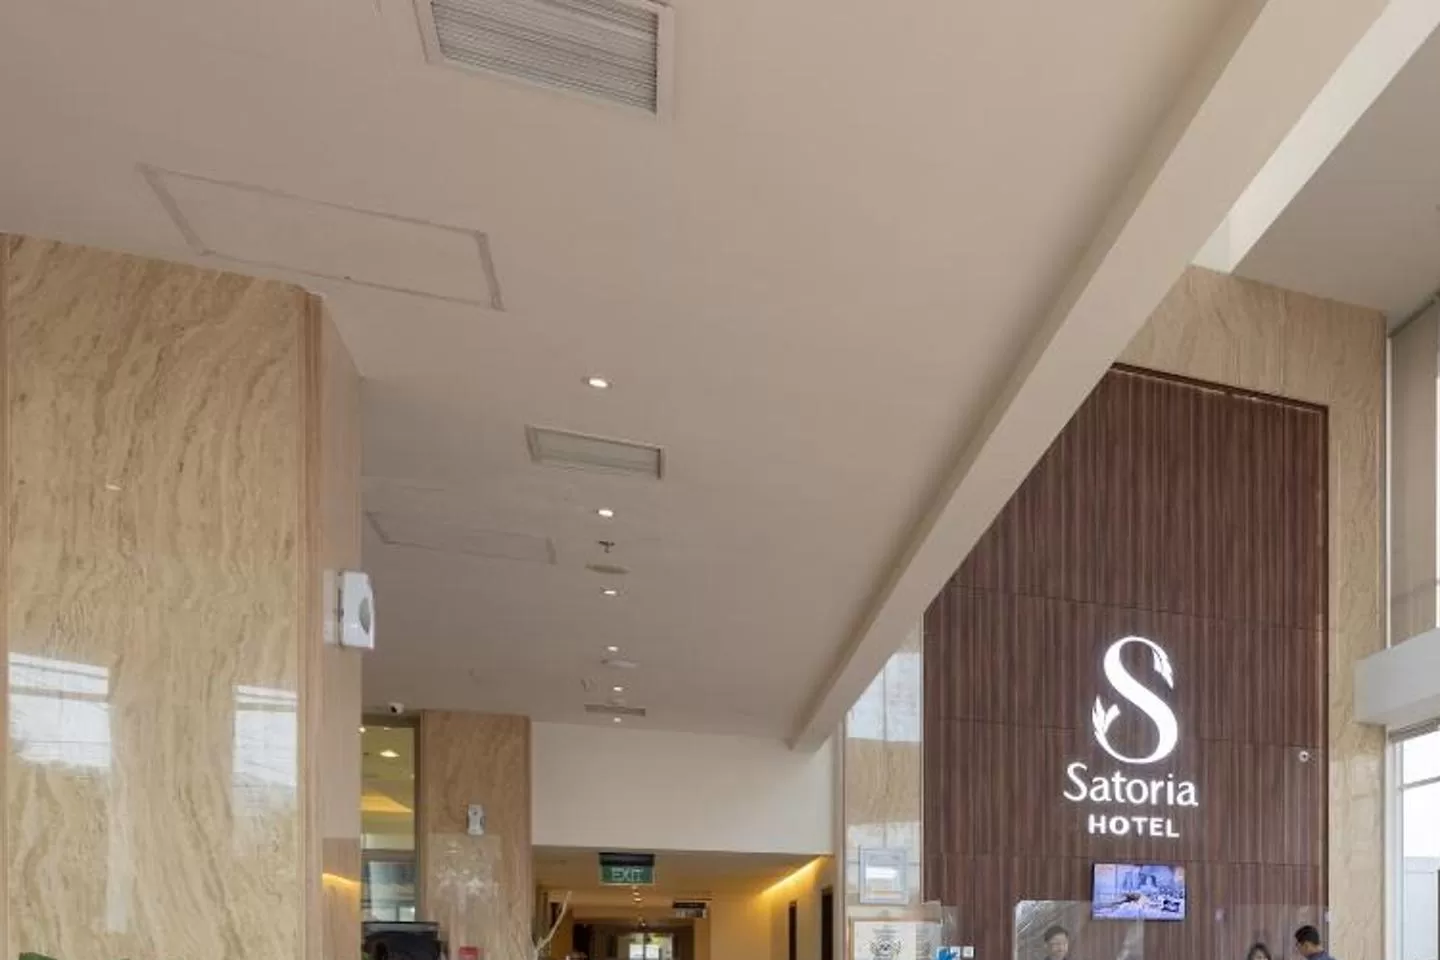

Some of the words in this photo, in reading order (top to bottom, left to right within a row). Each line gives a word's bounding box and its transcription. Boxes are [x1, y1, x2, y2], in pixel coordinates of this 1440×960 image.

[1064, 762, 1199, 807] Satoria
[1088, 814, 1180, 838] HOTEL
[611, 867, 644, 882] EXIT
